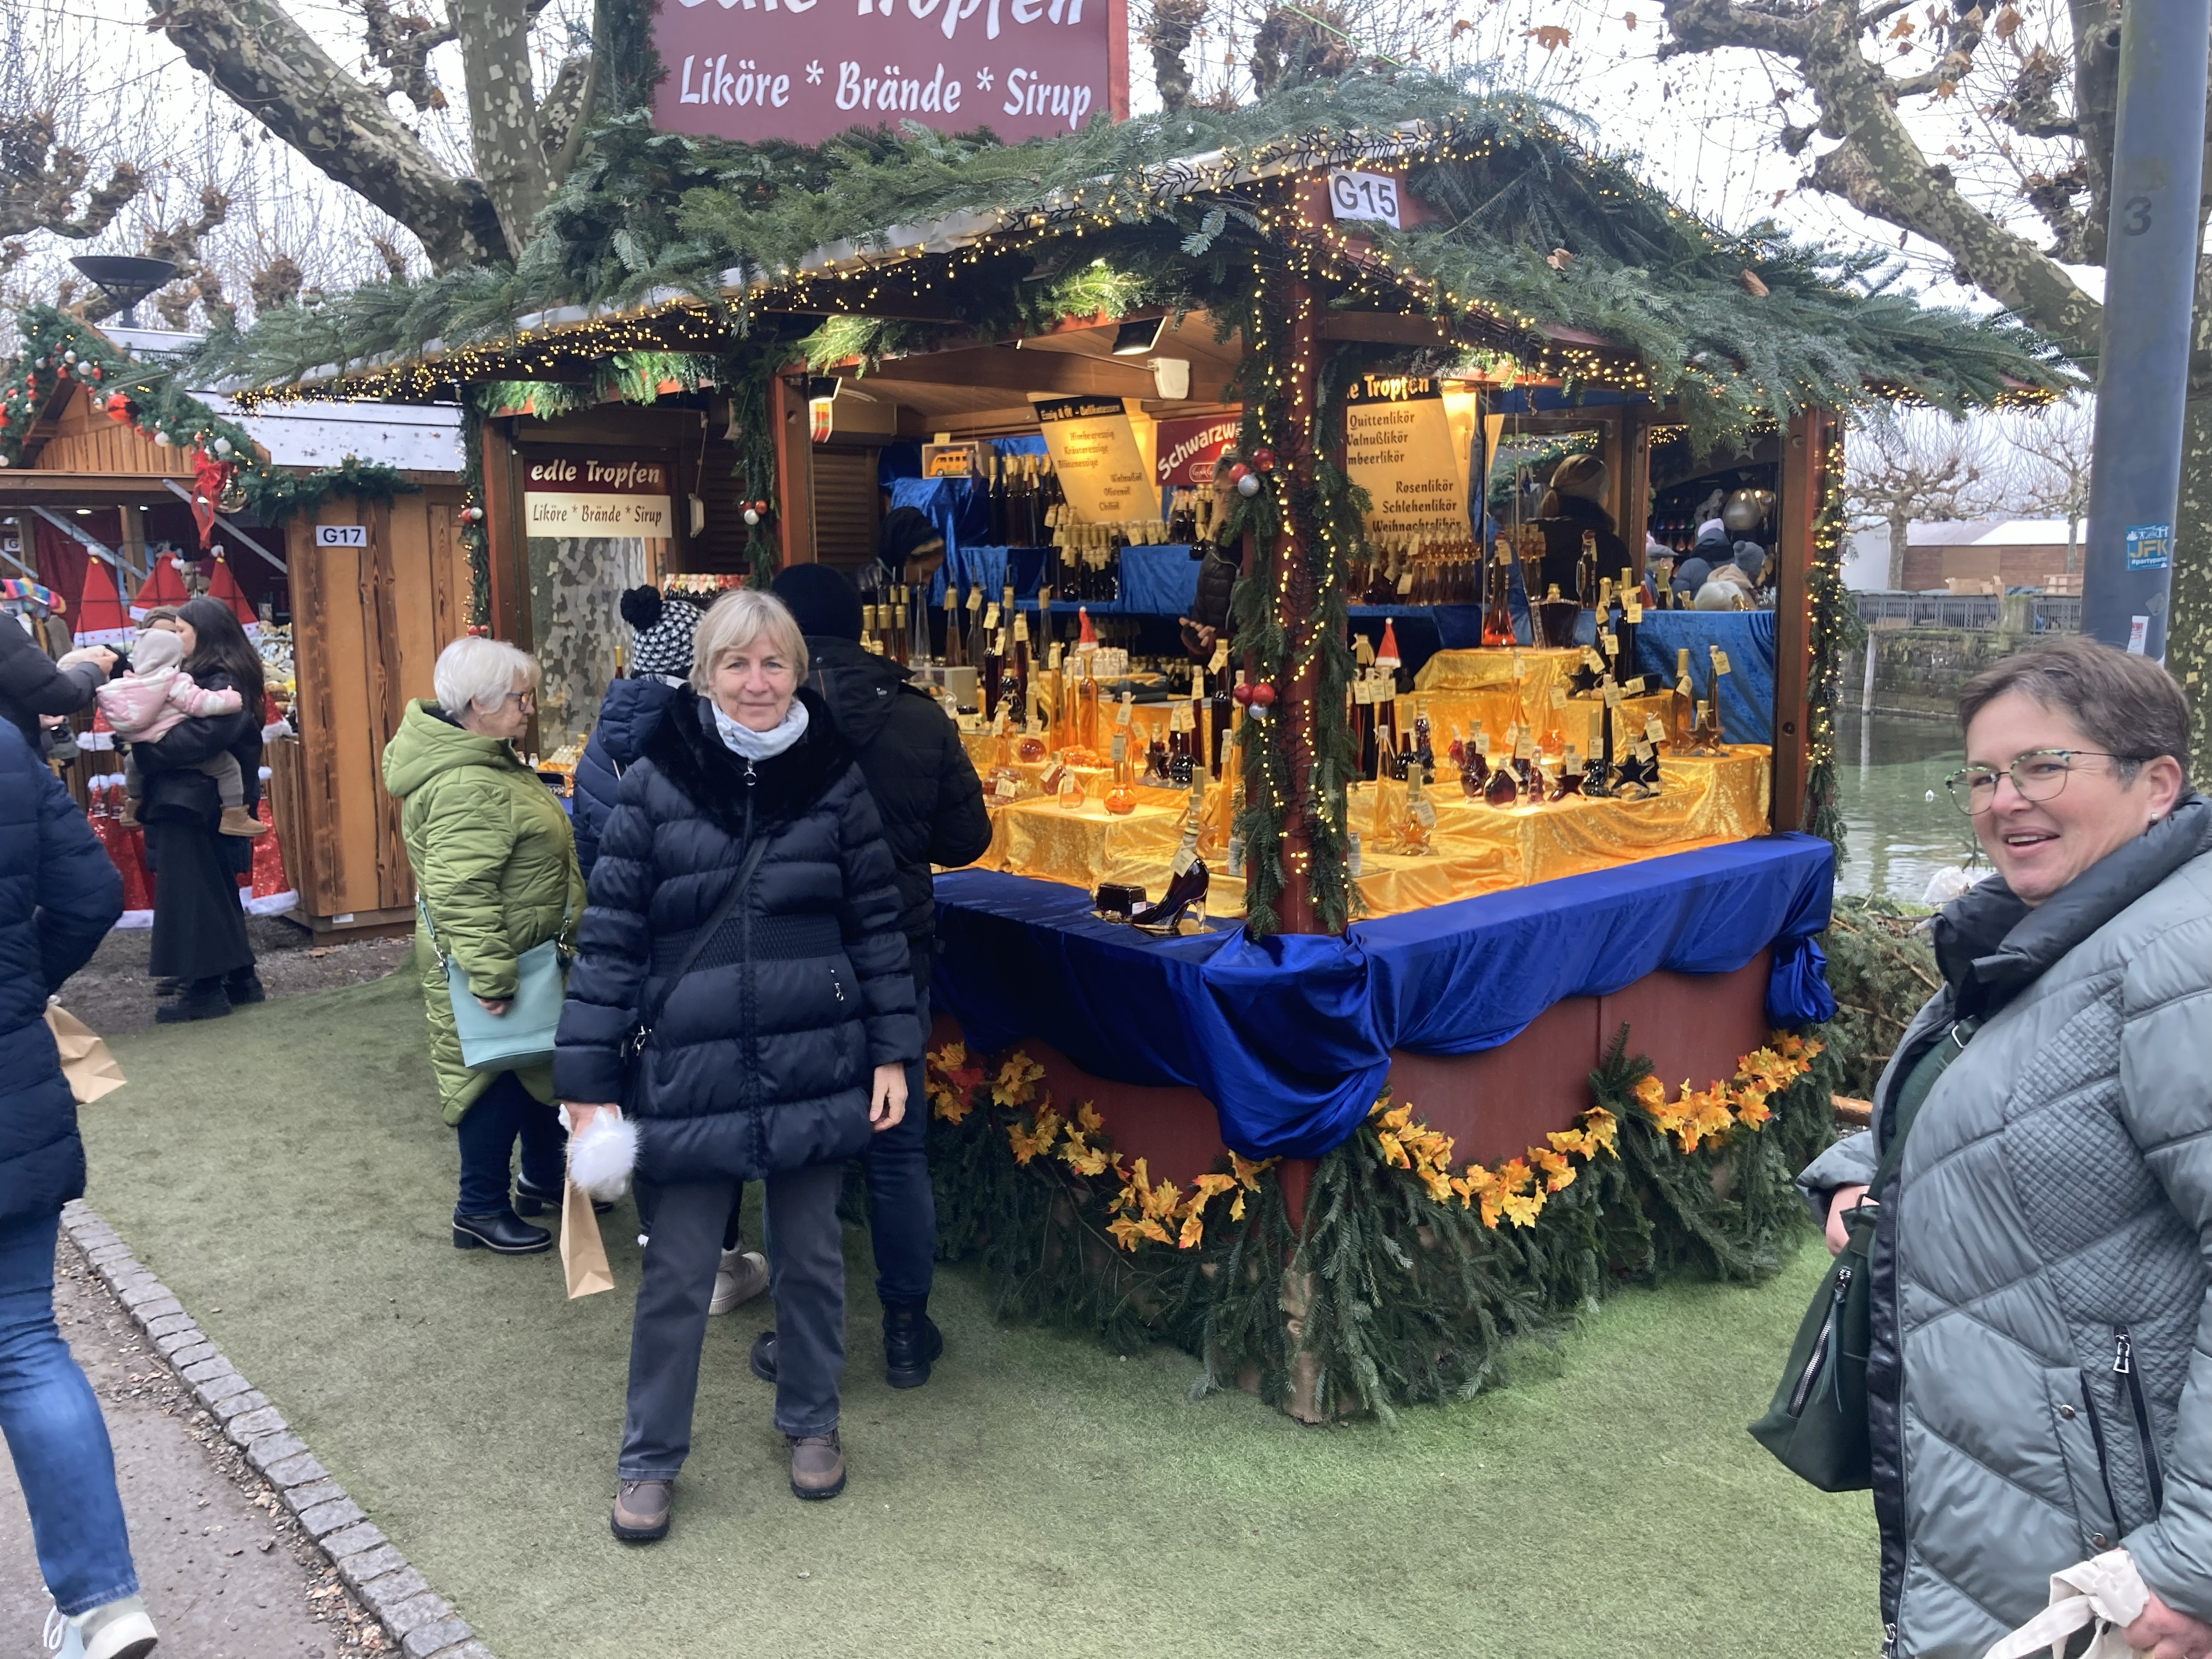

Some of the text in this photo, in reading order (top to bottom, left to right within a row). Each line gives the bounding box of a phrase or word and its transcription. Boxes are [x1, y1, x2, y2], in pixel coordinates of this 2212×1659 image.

[680, 54, 1092, 131] Liköre Brände Sirup
[1334, 175, 1396, 217] G15
[2123, 196, 2152, 236] 3
[1363, 375, 1429, 402] Tropfen
[1350, 410, 1414, 431] Quittenlikör
[1158, 422, 1237, 480] Schwarzw
[1348, 450, 1404, 465] mbeerlikör
[531, 459, 659, 489] edle Tropfen
[1396, 479, 1454, 494] Rosenlikör
[533, 504, 662, 527] Liköre Brände Sirup
[1383, 499, 1457, 514] Schlehenlikör
[323, 528, 360, 543] G17
[2130, 539, 2168, 558] JFK
